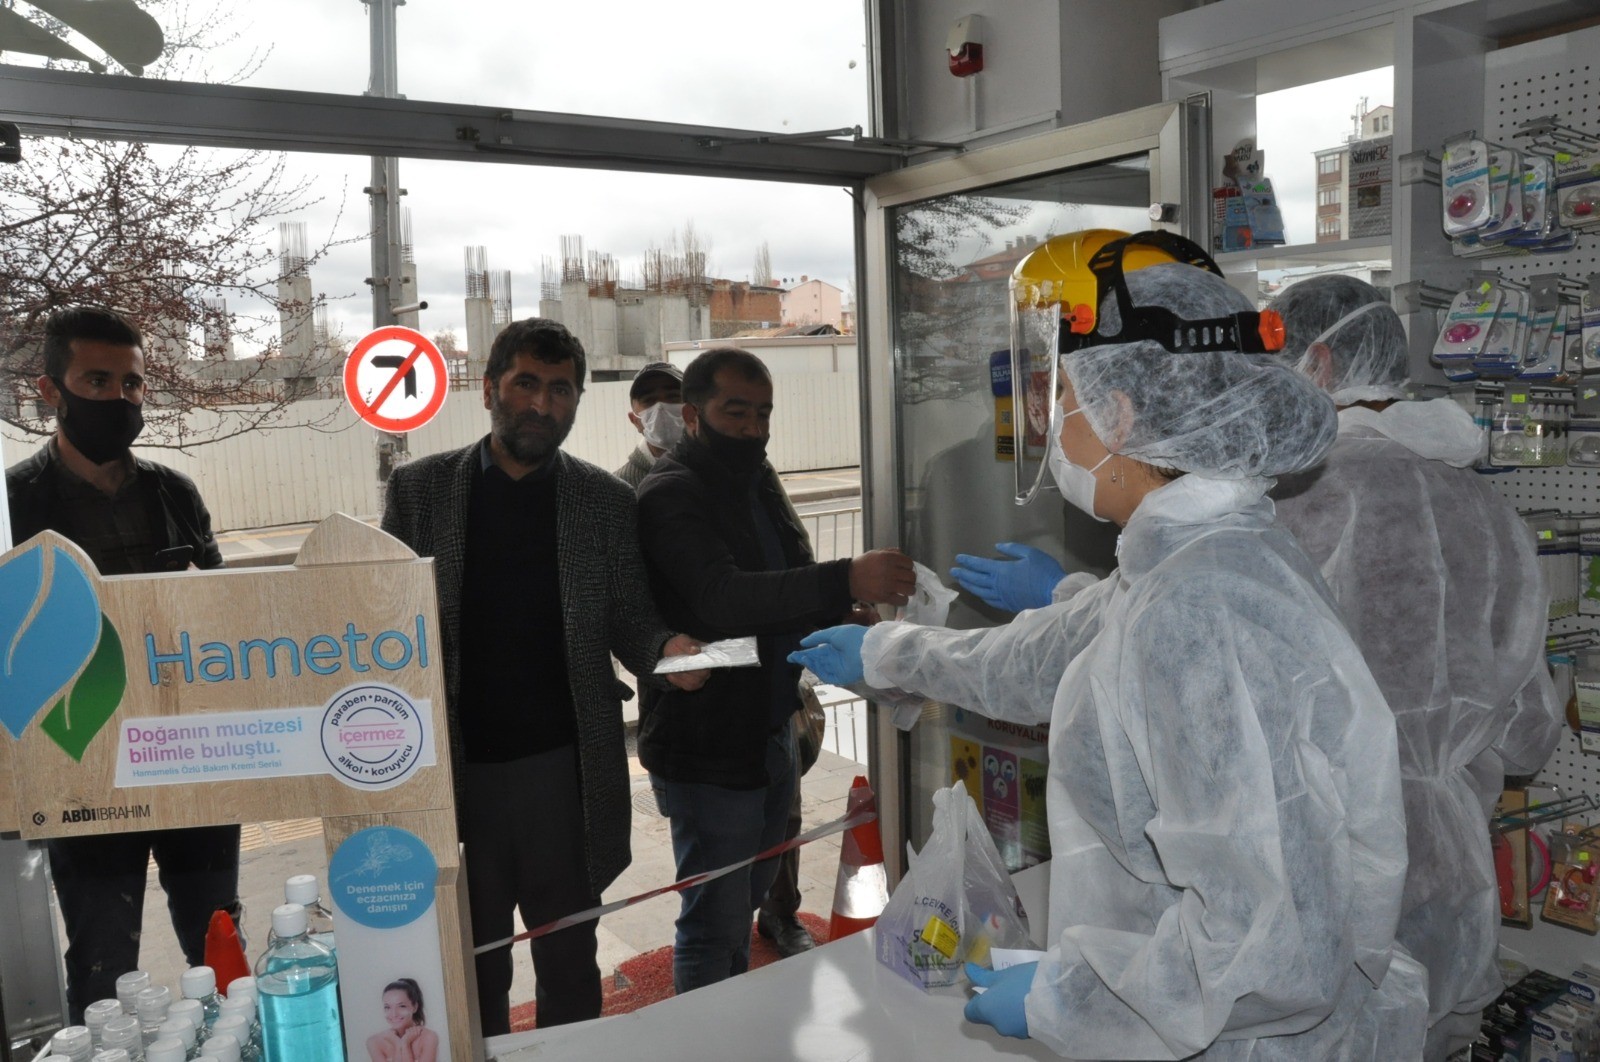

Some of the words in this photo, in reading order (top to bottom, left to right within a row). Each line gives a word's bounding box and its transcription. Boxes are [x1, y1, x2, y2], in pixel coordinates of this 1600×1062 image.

[145, 613, 429, 686] Hametol
[331, 694, 367, 726] paraben
[374, 694, 409, 720] parfüm
[127, 726, 210, 745] Doğanın
[216, 717, 302, 737] mucizesi
[338, 728, 405, 745] içermez
[129, 745, 195, 763] bilimle
[201, 741, 281, 759] buluştu.
[338, 755, 363, 774] alkol
[371, 744, 413, 776] koruyucu
[133, 768, 179, 777] Hamamelis
[181, 764, 201, 774] Özlü
[203, 764, 229, 773] Bakım
[231, 762, 256, 771] Kremi
[258, 760, 282, 769] Serisi
[346, 882, 401, 894] Denemek
[404, 880, 424, 891] için
[356, 892, 416, 904] eczacınıza
[367, 903, 408, 913] danışın
